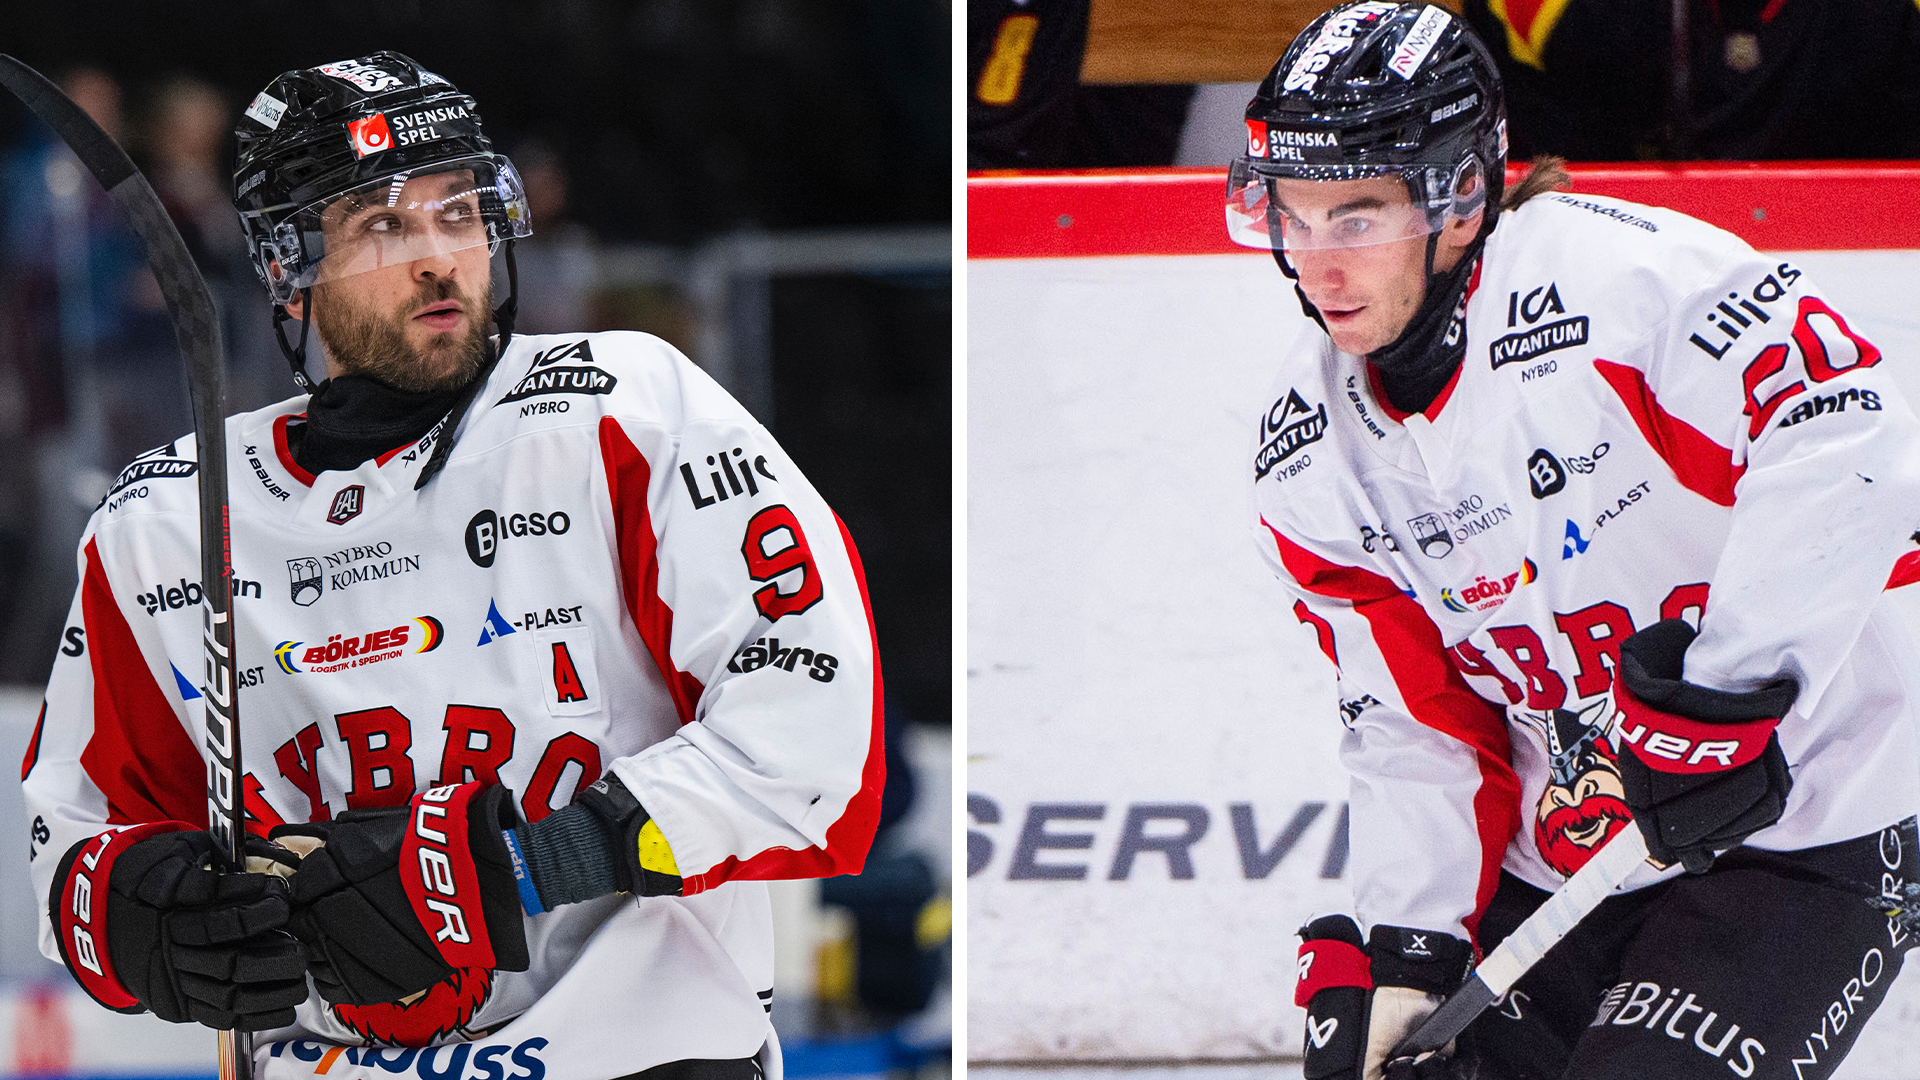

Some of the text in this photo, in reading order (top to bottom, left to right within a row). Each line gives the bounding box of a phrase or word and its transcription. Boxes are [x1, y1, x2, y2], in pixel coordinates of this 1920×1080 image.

[392, 103, 469, 131] SVENSKA
[1430, 93, 1478, 123] BAUER
[397, 125, 441, 147] SPEL
[1270, 131, 1338, 147] SVENSKA
[1271, 145, 1305, 161] SPEL
[1507, 281, 1566, 328] ICA
[1689, 262, 1802, 361] Liljas
[524, 339, 595, 377] ICA
[1493, 321, 1584, 364] KVANTUM
[510, 371, 609, 396] VANTUM
[1521, 360, 1558, 382] NYBRO
[519, 400, 570, 418] NYBRO
[1259, 387, 1313, 446] ICA
[1347, 391, 1386, 441] BAUER
[1256, 413, 1323, 471] VANTU
[106, 462, 193, 498] VANTUM
[108, 486, 149, 513] NYBRO
[248, 457, 291, 502] BAUER
[323, 541, 393, 568] NYBRO
[470, 510, 571, 563] BIGSO
[331, 554, 421, 592] KOMMUN
[740, 503, 824, 624] 9
[1460, 571, 1520, 605] BÖRJ
[302, 625, 410, 664] BÖRJES
[310, 649, 404, 674] LOGISTIK & SPEDITION
[1455, 582, 1711, 711] YBR
[551, 641, 589, 703] A
[1614, 710, 1740, 786] UER
[415, 783, 471, 945] AUER
[73, 821, 148, 977] BAU
[1612, 982, 1766, 1079] Bitus
[1791, 948, 1884, 1080] NYBRO
